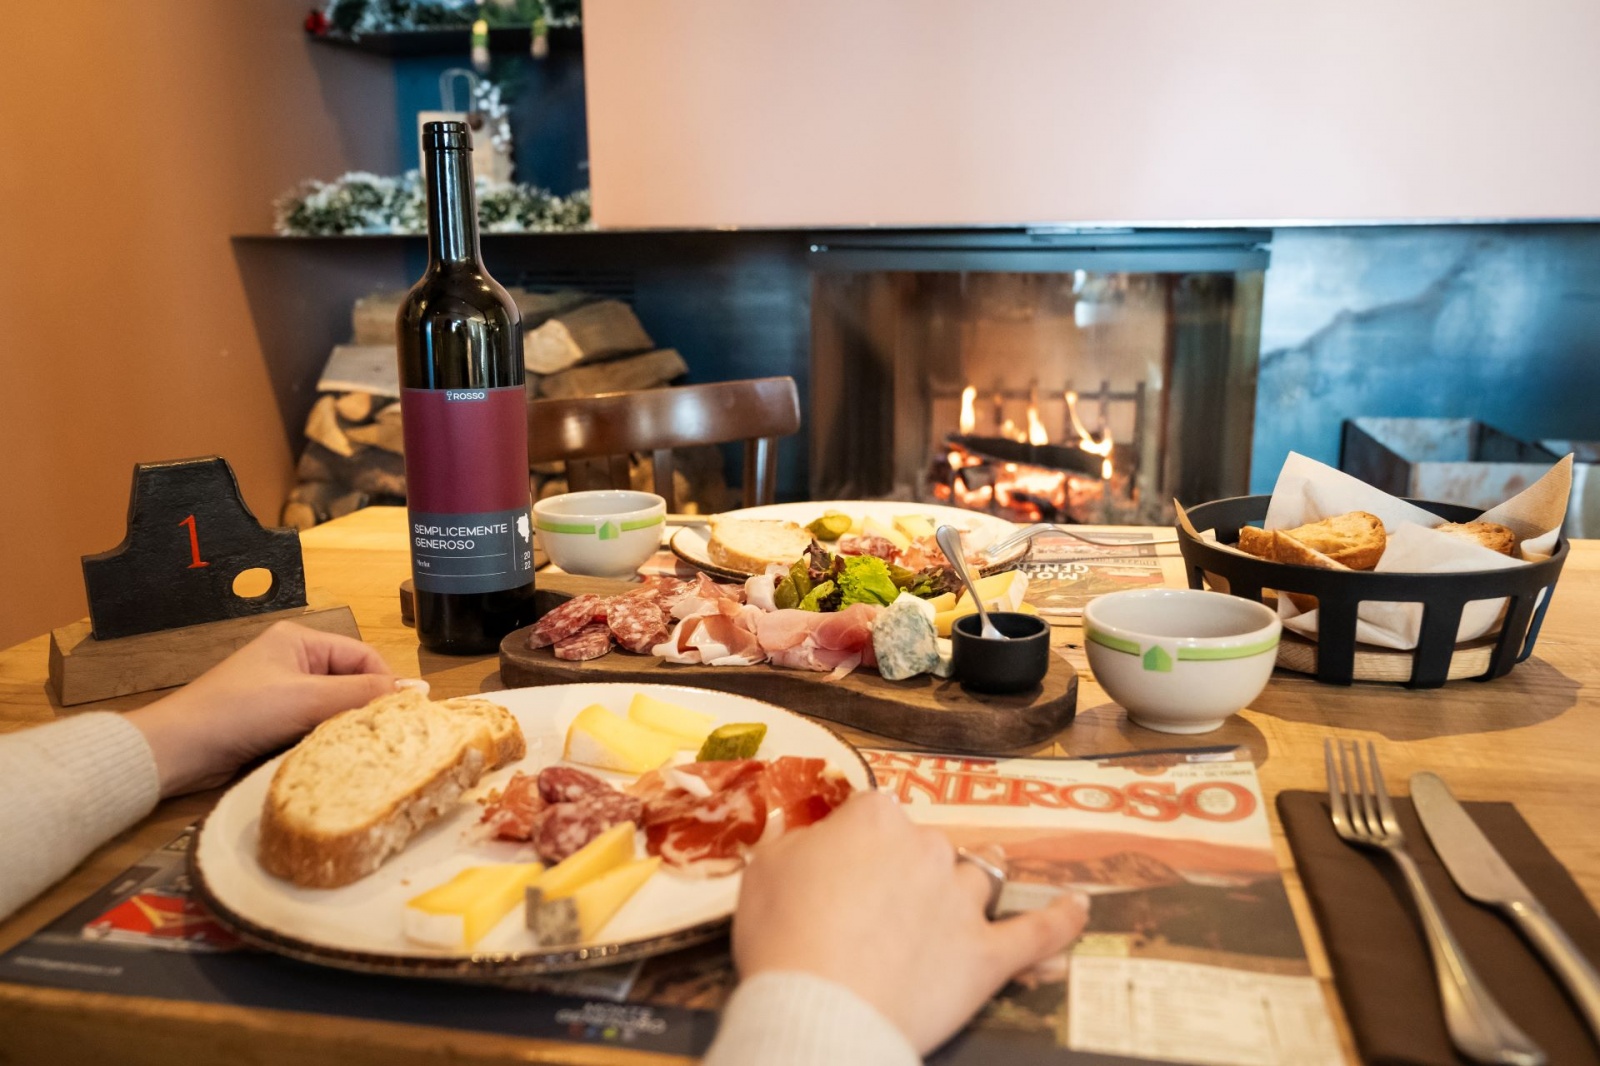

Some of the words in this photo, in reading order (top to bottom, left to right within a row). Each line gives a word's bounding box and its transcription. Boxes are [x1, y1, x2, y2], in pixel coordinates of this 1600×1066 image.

[453, 392, 485, 400] ROSSO
[414, 523, 508, 537] SEMPLICEMENTE
[178, 514, 210, 568] 1
[415, 537, 475, 550] GENEROSO
[523, 550, 531, 560] 20
[870, 767, 1257, 822] NEROSO
